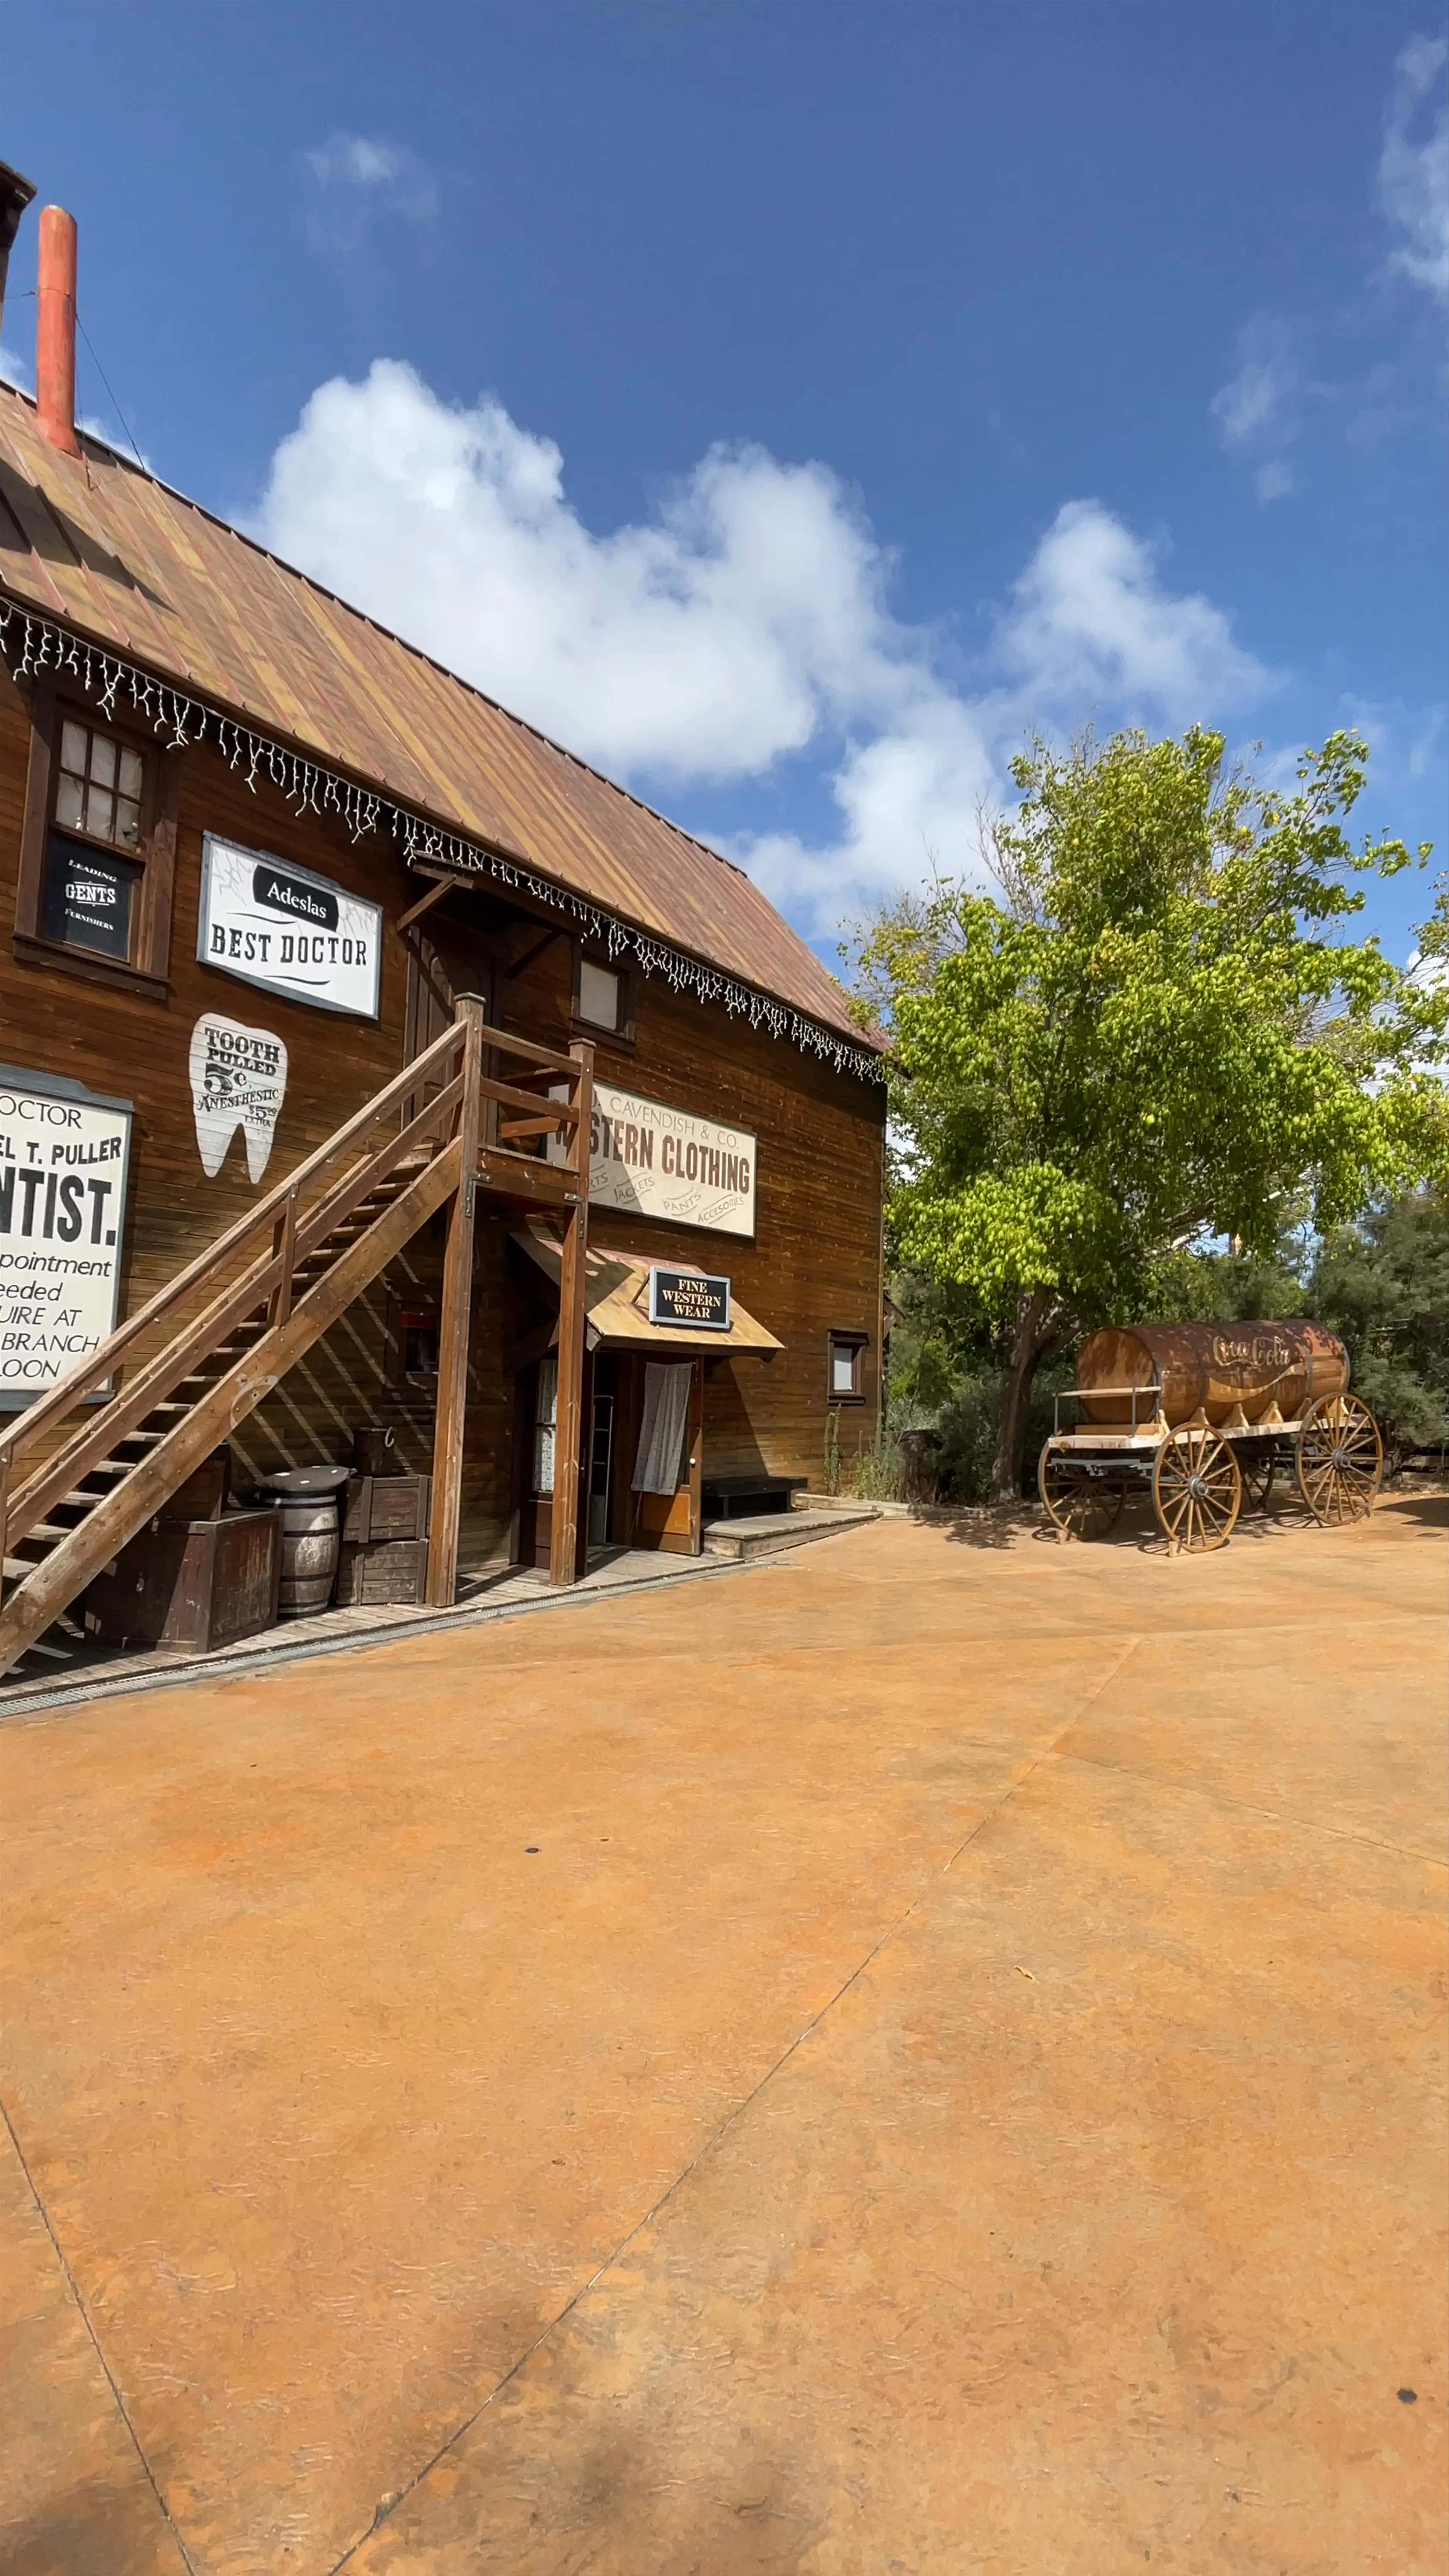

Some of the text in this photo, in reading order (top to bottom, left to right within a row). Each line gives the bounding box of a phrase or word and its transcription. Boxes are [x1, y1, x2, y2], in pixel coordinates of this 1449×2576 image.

[68, 859, 117, 882] LEADING
[65, 883, 116, 904] GENTS
[267, 882, 327, 918] Adeslas
[65, 907, 114, 931] FURNISHERS
[210, 923, 367, 966] BEST DOCTOR
[205, 1027, 280, 1063] TOOTH
[208, 1047, 276, 1077] PULLED
[197, 1089, 279, 1112] ANESTHESTIC
[610, 1097, 695, 1136] CAVENDISH
[701, 1125, 710, 1140] &
[717, 1131, 740, 1150] CO.
[26, 1141, 42, 1164] T.
[51, 1137, 122, 1166] PULLER
[555, 1112, 750, 1194] STERN CLOTHING
[614, 1177, 655, 1203] JACKETS
[663, 1191, 702, 1211] PANTS
[697, 1196, 744, 1223] ACCESORIES
[678, 1279, 708, 1293] FINE
[662, 1289, 721, 1307] WESTERN
[53, 1309, 82, 1326] AT
[673, 1304, 710, 1318] WEAR
[2, 1333, 100, 1352] BRANCH
[0, 1359, 60, 1378] OON
